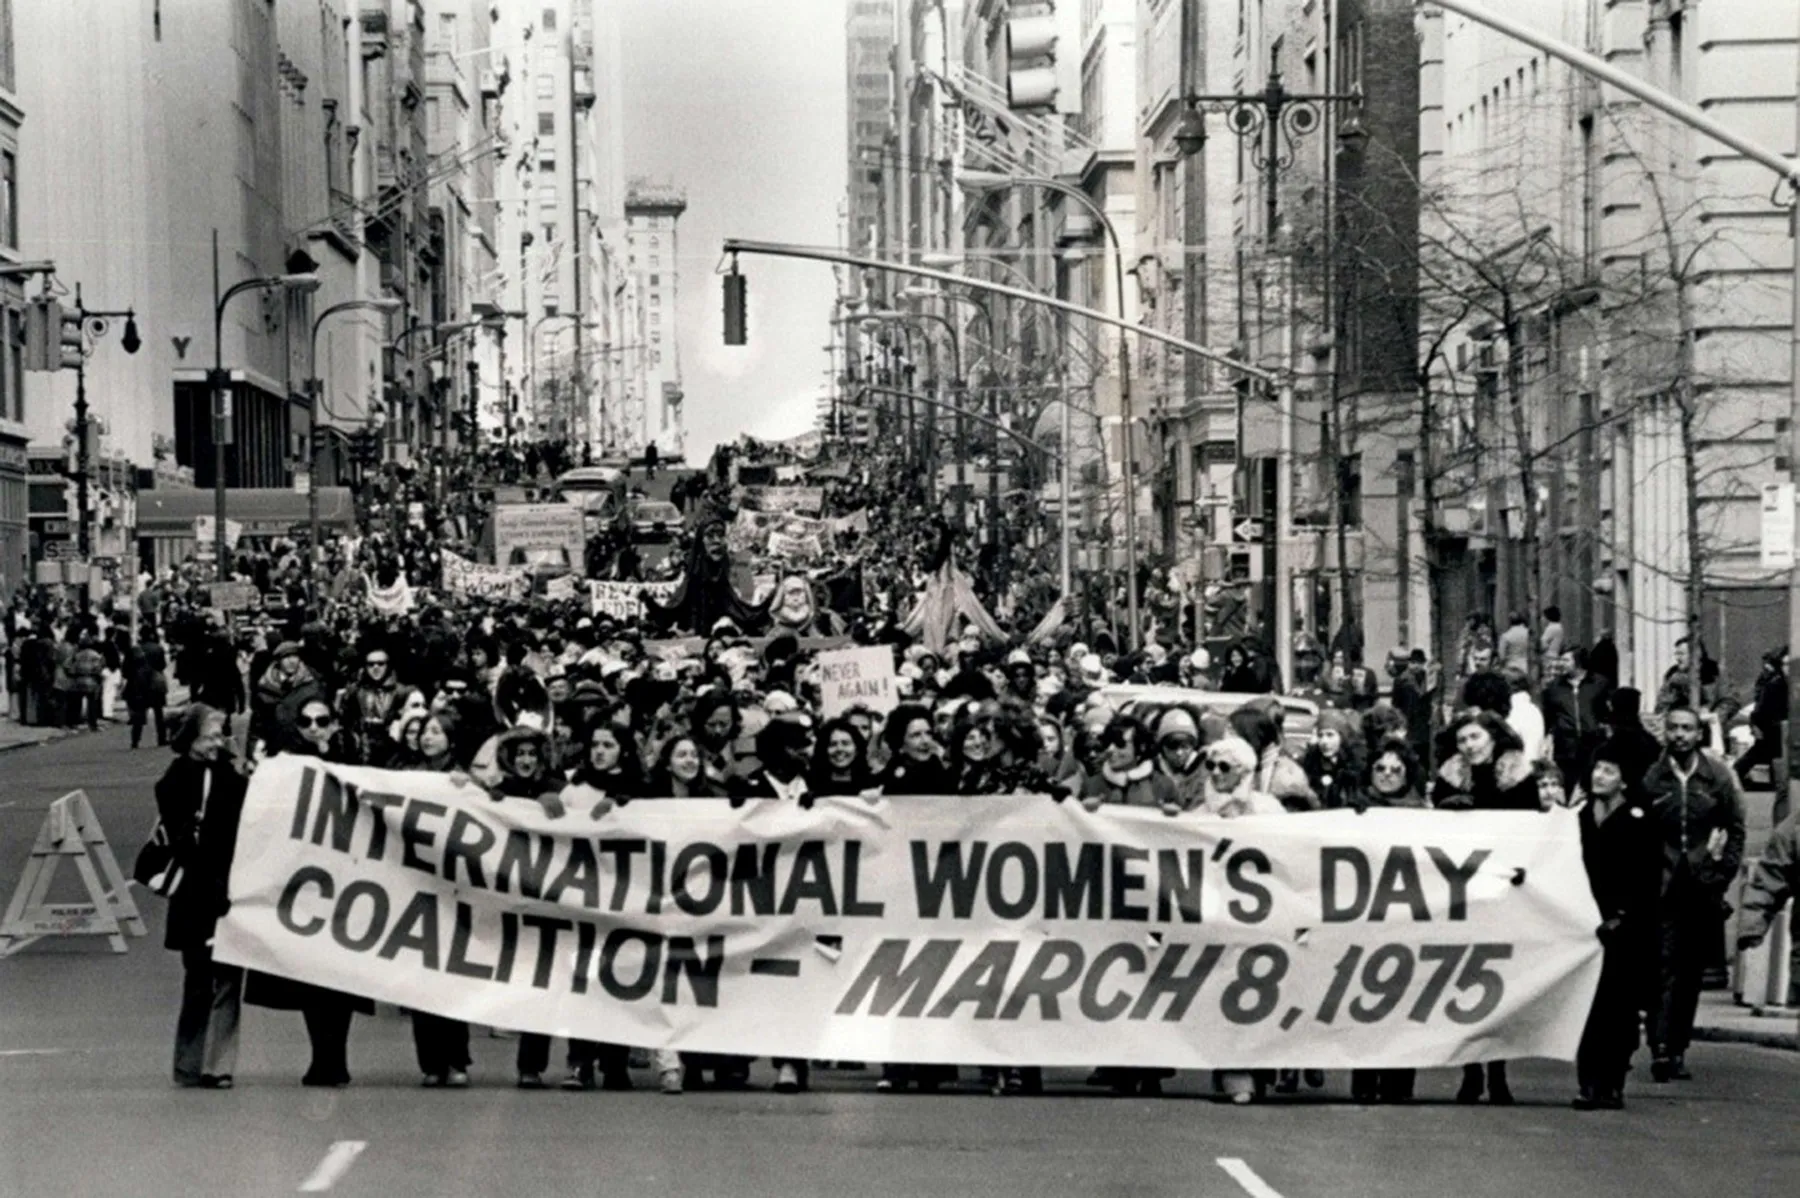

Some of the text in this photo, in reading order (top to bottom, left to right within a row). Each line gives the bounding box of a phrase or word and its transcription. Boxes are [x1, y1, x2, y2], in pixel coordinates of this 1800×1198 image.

[823, 661, 860, 681] NEVER
[839, 677, 889, 699] AGAIN!
[290, 766, 1492, 924] INTERNATIONAL WOMEN'S DAY
[276, 865, 725, 1007] COALITION
[834, 937, 1224, 1022] MARCH
